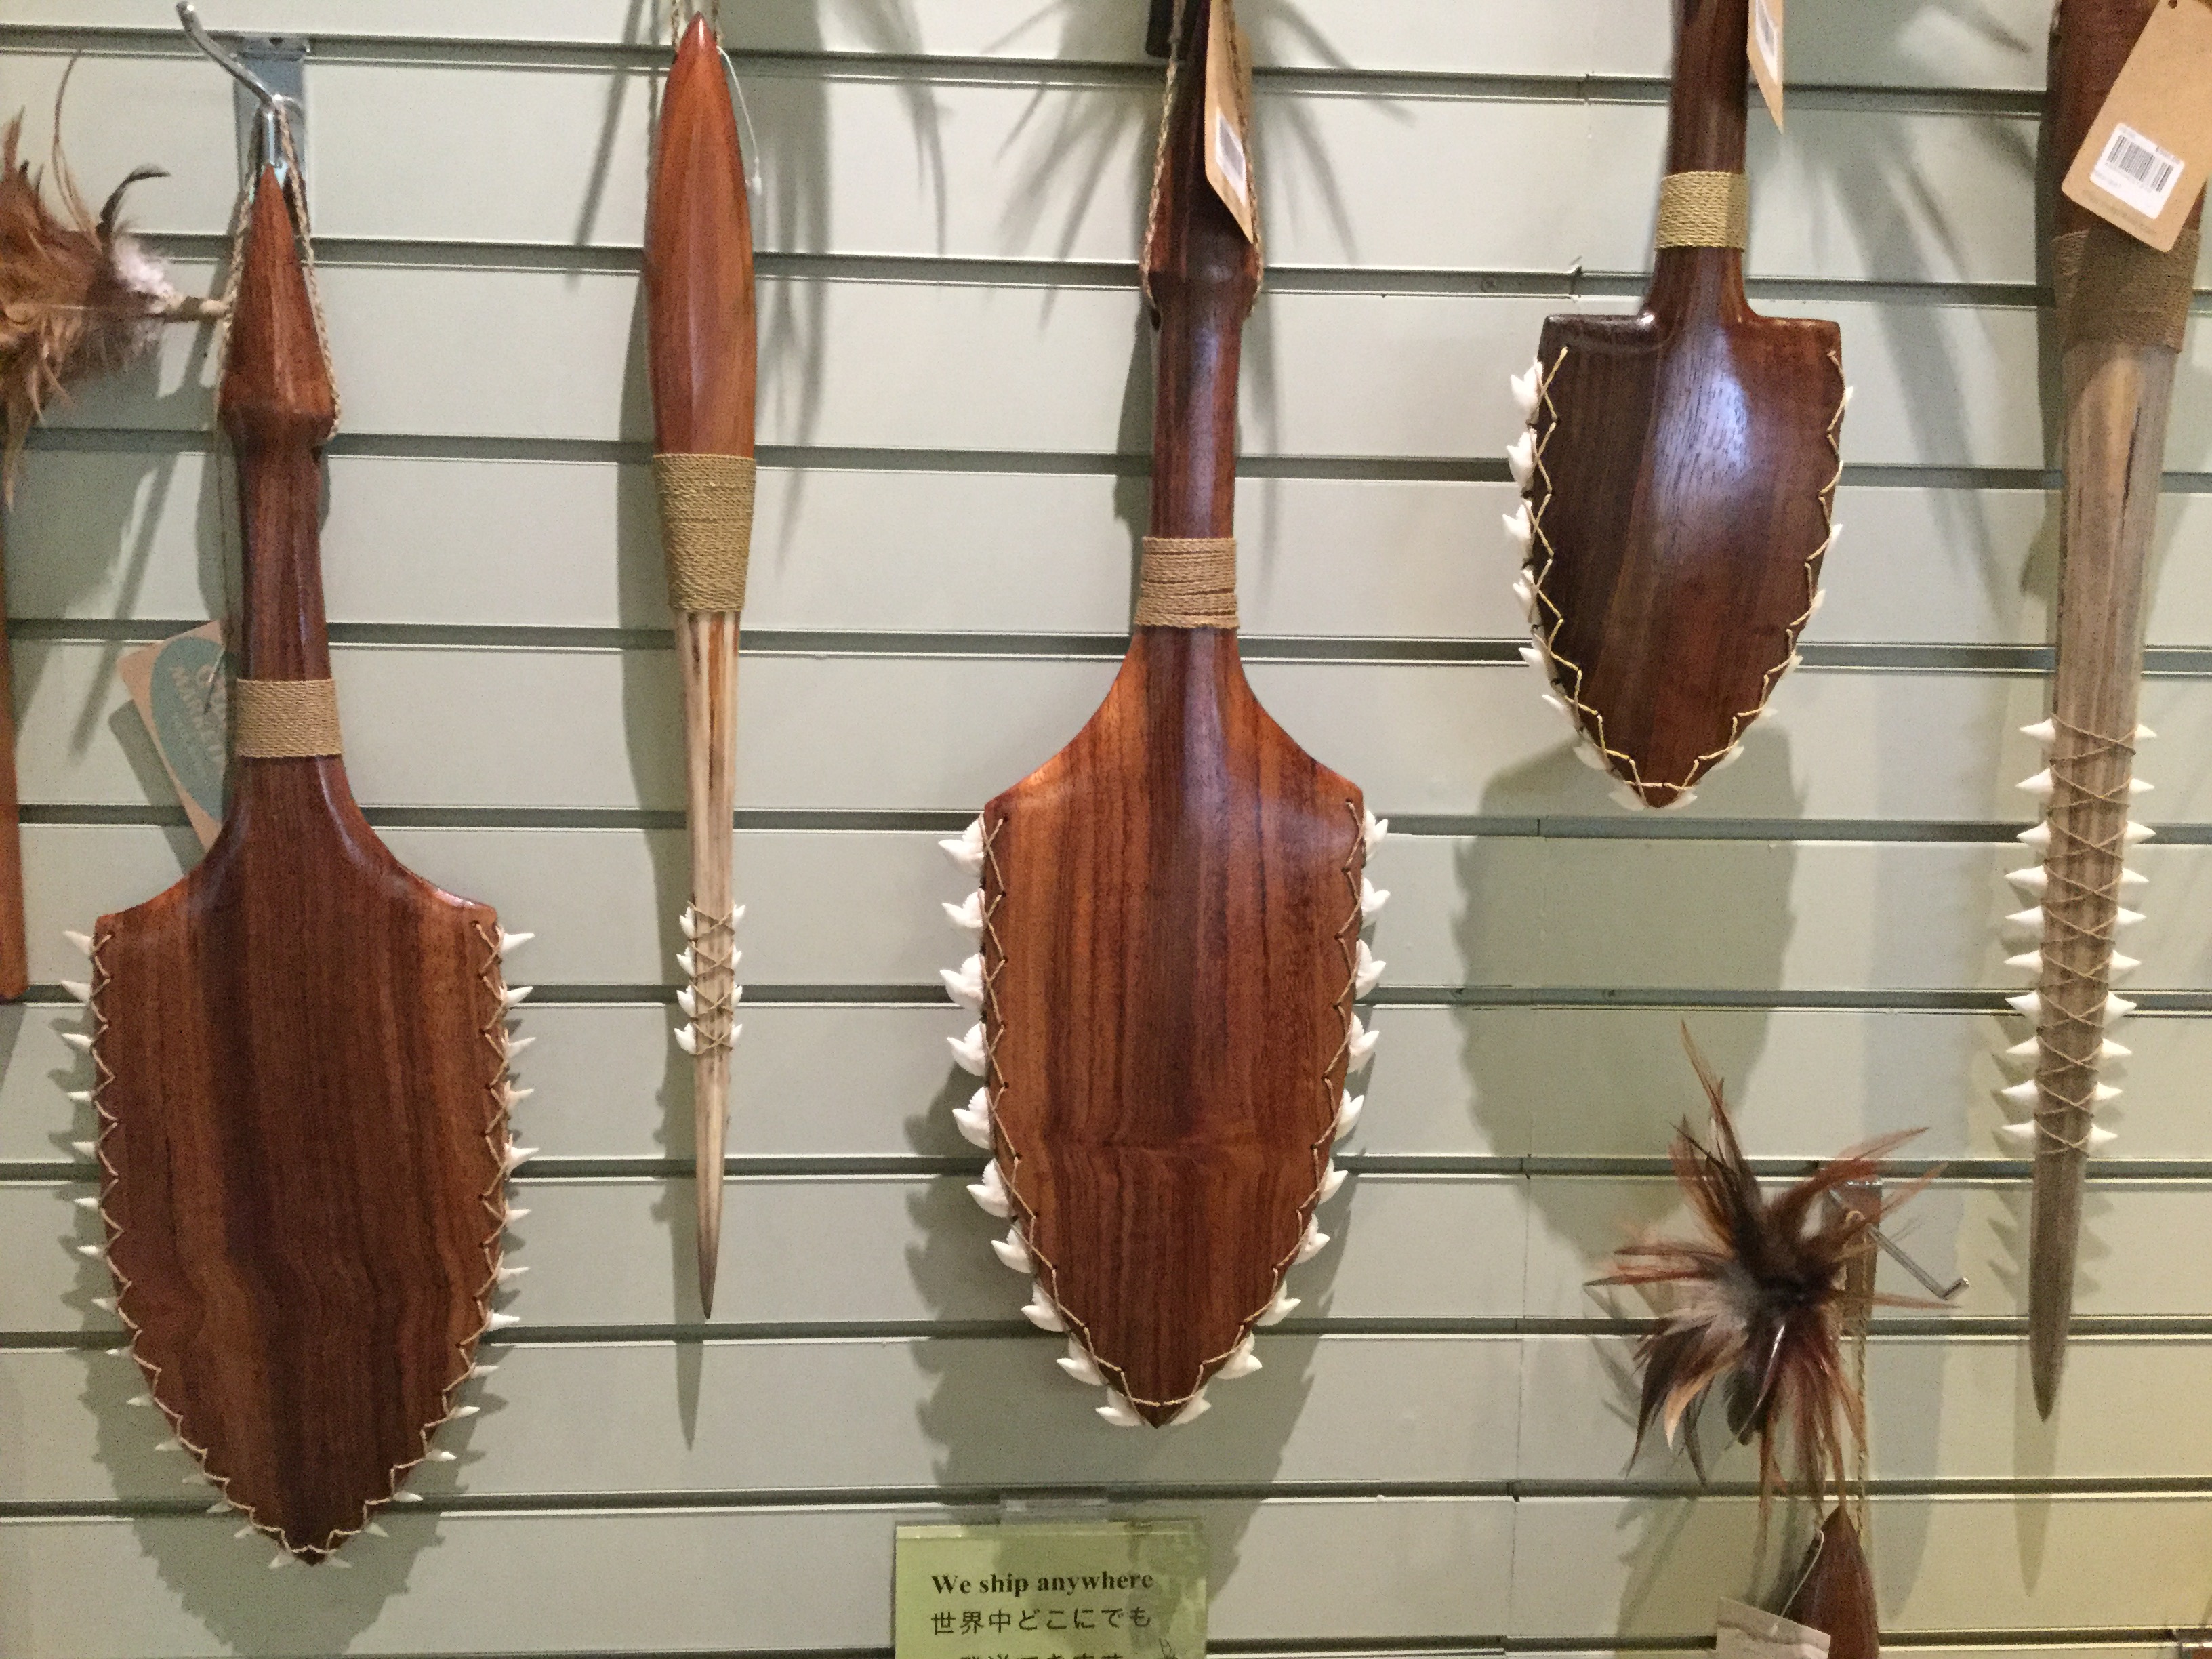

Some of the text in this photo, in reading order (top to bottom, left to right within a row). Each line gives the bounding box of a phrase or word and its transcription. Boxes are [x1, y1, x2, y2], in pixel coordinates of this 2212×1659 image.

[931, 1570, 1153, 1598] We ship anywhere
[930, 1606, 1152, 1635] 世界中どこにでも
